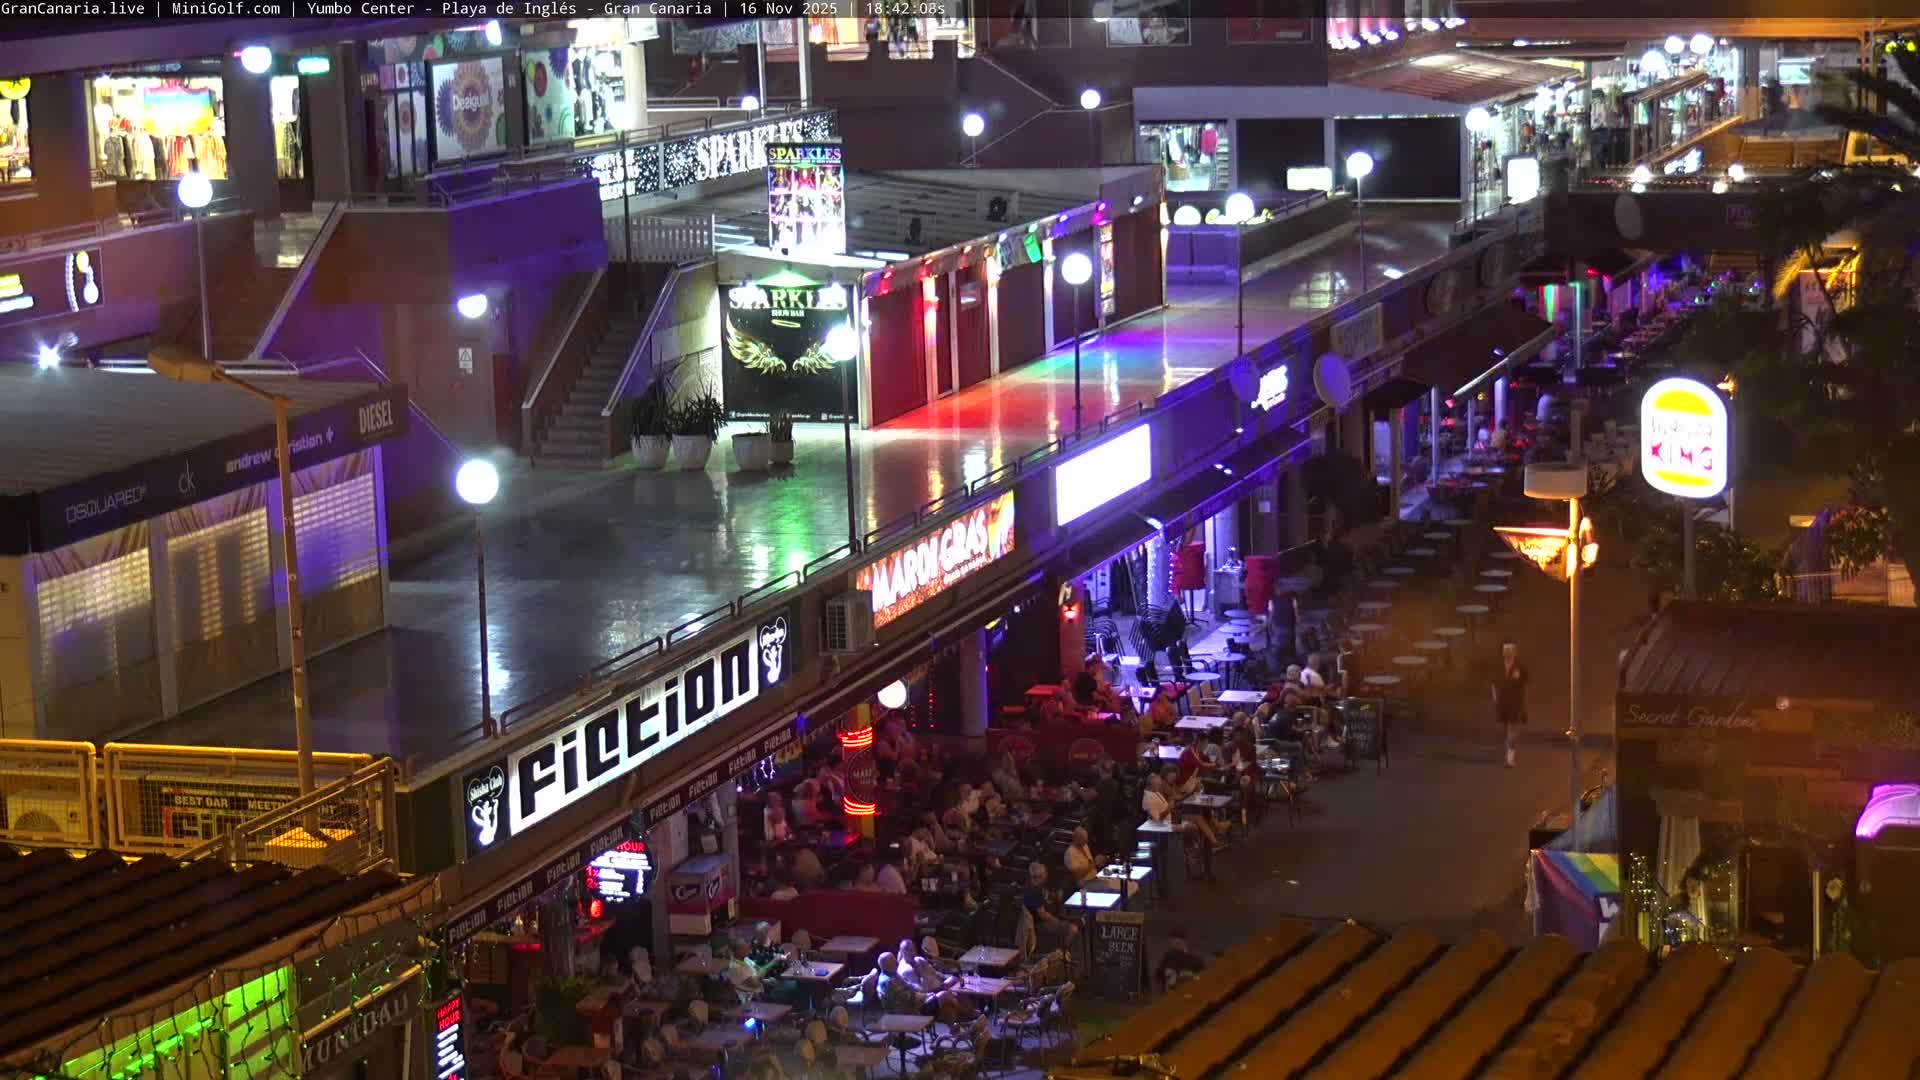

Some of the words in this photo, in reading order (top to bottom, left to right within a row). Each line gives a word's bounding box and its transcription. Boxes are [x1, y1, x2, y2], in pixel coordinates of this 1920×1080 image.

[697, 118, 803, 181] SPARKLES
[768, 147, 842, 160] SPARKLES
[728, 286, 848, 310] SPARKLES
[790, 309, 805, 317] BAR
[359, 399, 394, 435] DIESEL
[226, 449, 272, 473] andrew
[274, 431, 323, 459] cristian
[1650, 441, 1714, 471] KING
[178, 457, 197, 494] ck
[871, 536, 939, 614] MARDI
[938, 508, 989, 573] GRAS
[517, 638, 751, 820] Fiction
[470, 783, 490, 801] Shisha
[490, 774, 503, 791] Club
[175, 796, 203, 807] BEST
[1101, 925, 1138, 941] LARGE
[1107, 941, 1136, 953] BEER
[437, 997, 460, 1020] HAPPY
[438, 1010, 461, 1032] HOUR
